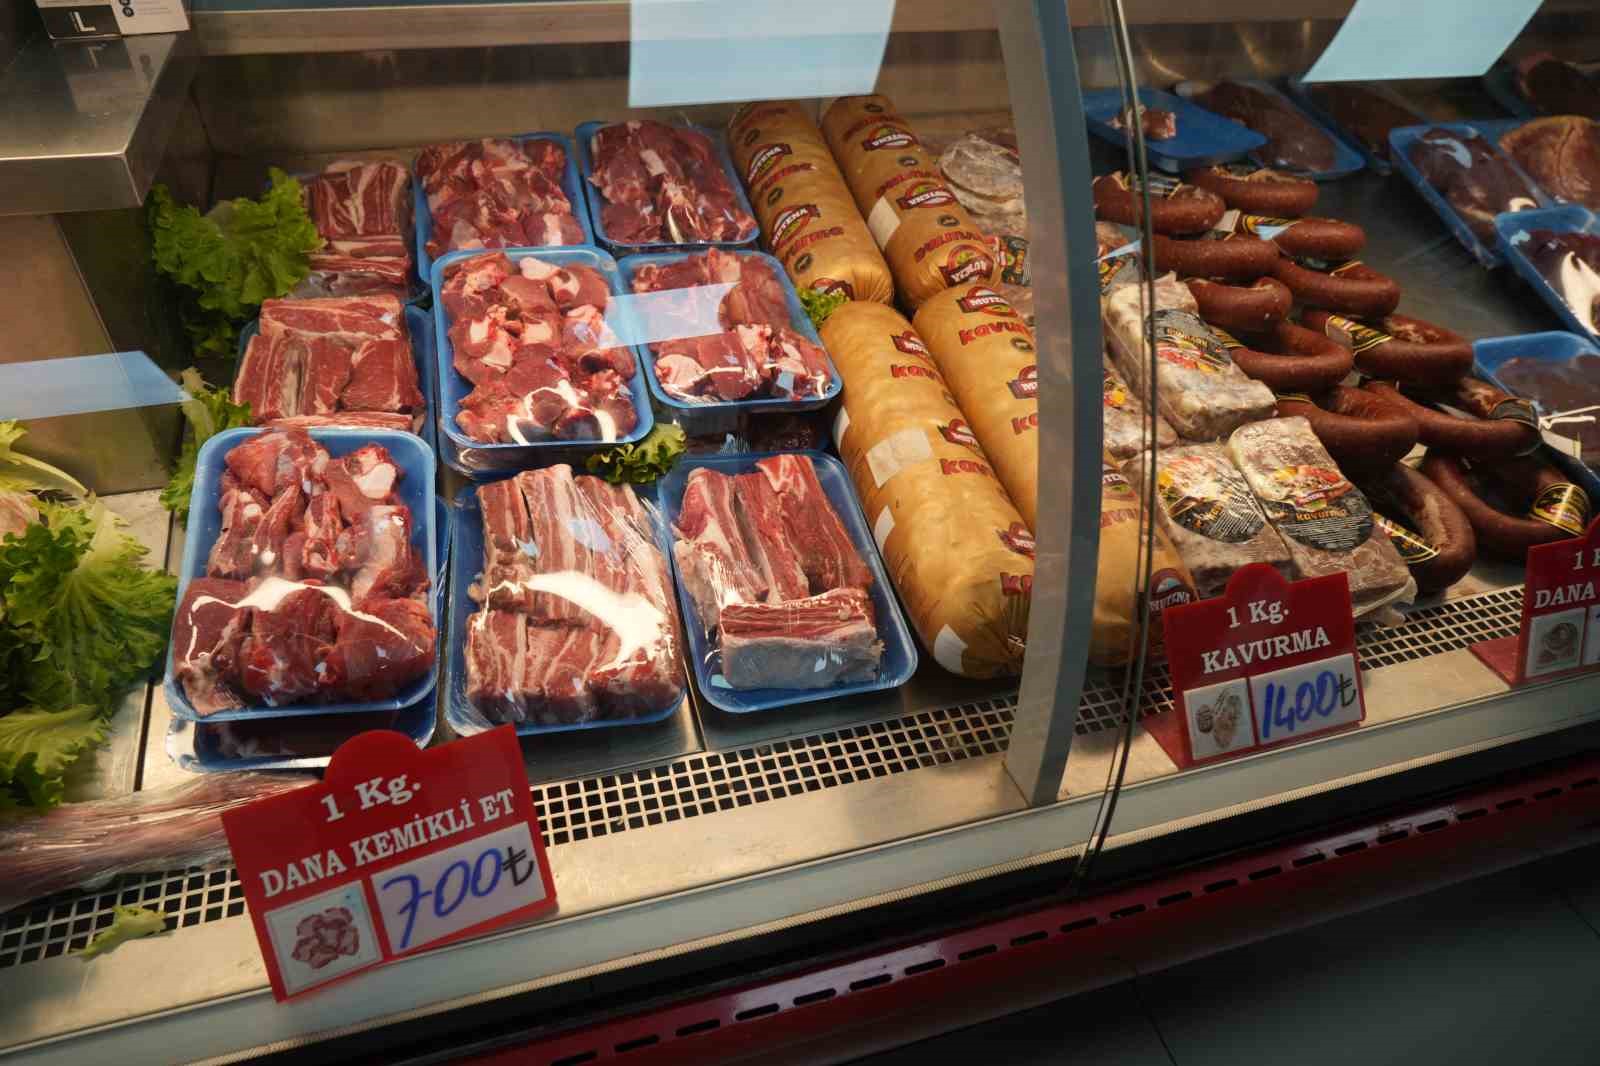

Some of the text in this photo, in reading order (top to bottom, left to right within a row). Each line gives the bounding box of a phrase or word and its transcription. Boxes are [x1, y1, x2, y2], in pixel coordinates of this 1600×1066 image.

[1227, 599, 1290, 629] 1 Kg.
[1534, 581, 1597, 609] DANA
[1201, 626, 1331, 675] KAVURMA
[321, 774, 422, 823] 1 Kg.
[259, 788, 515, 897] DANA KEMİKLİ ET
